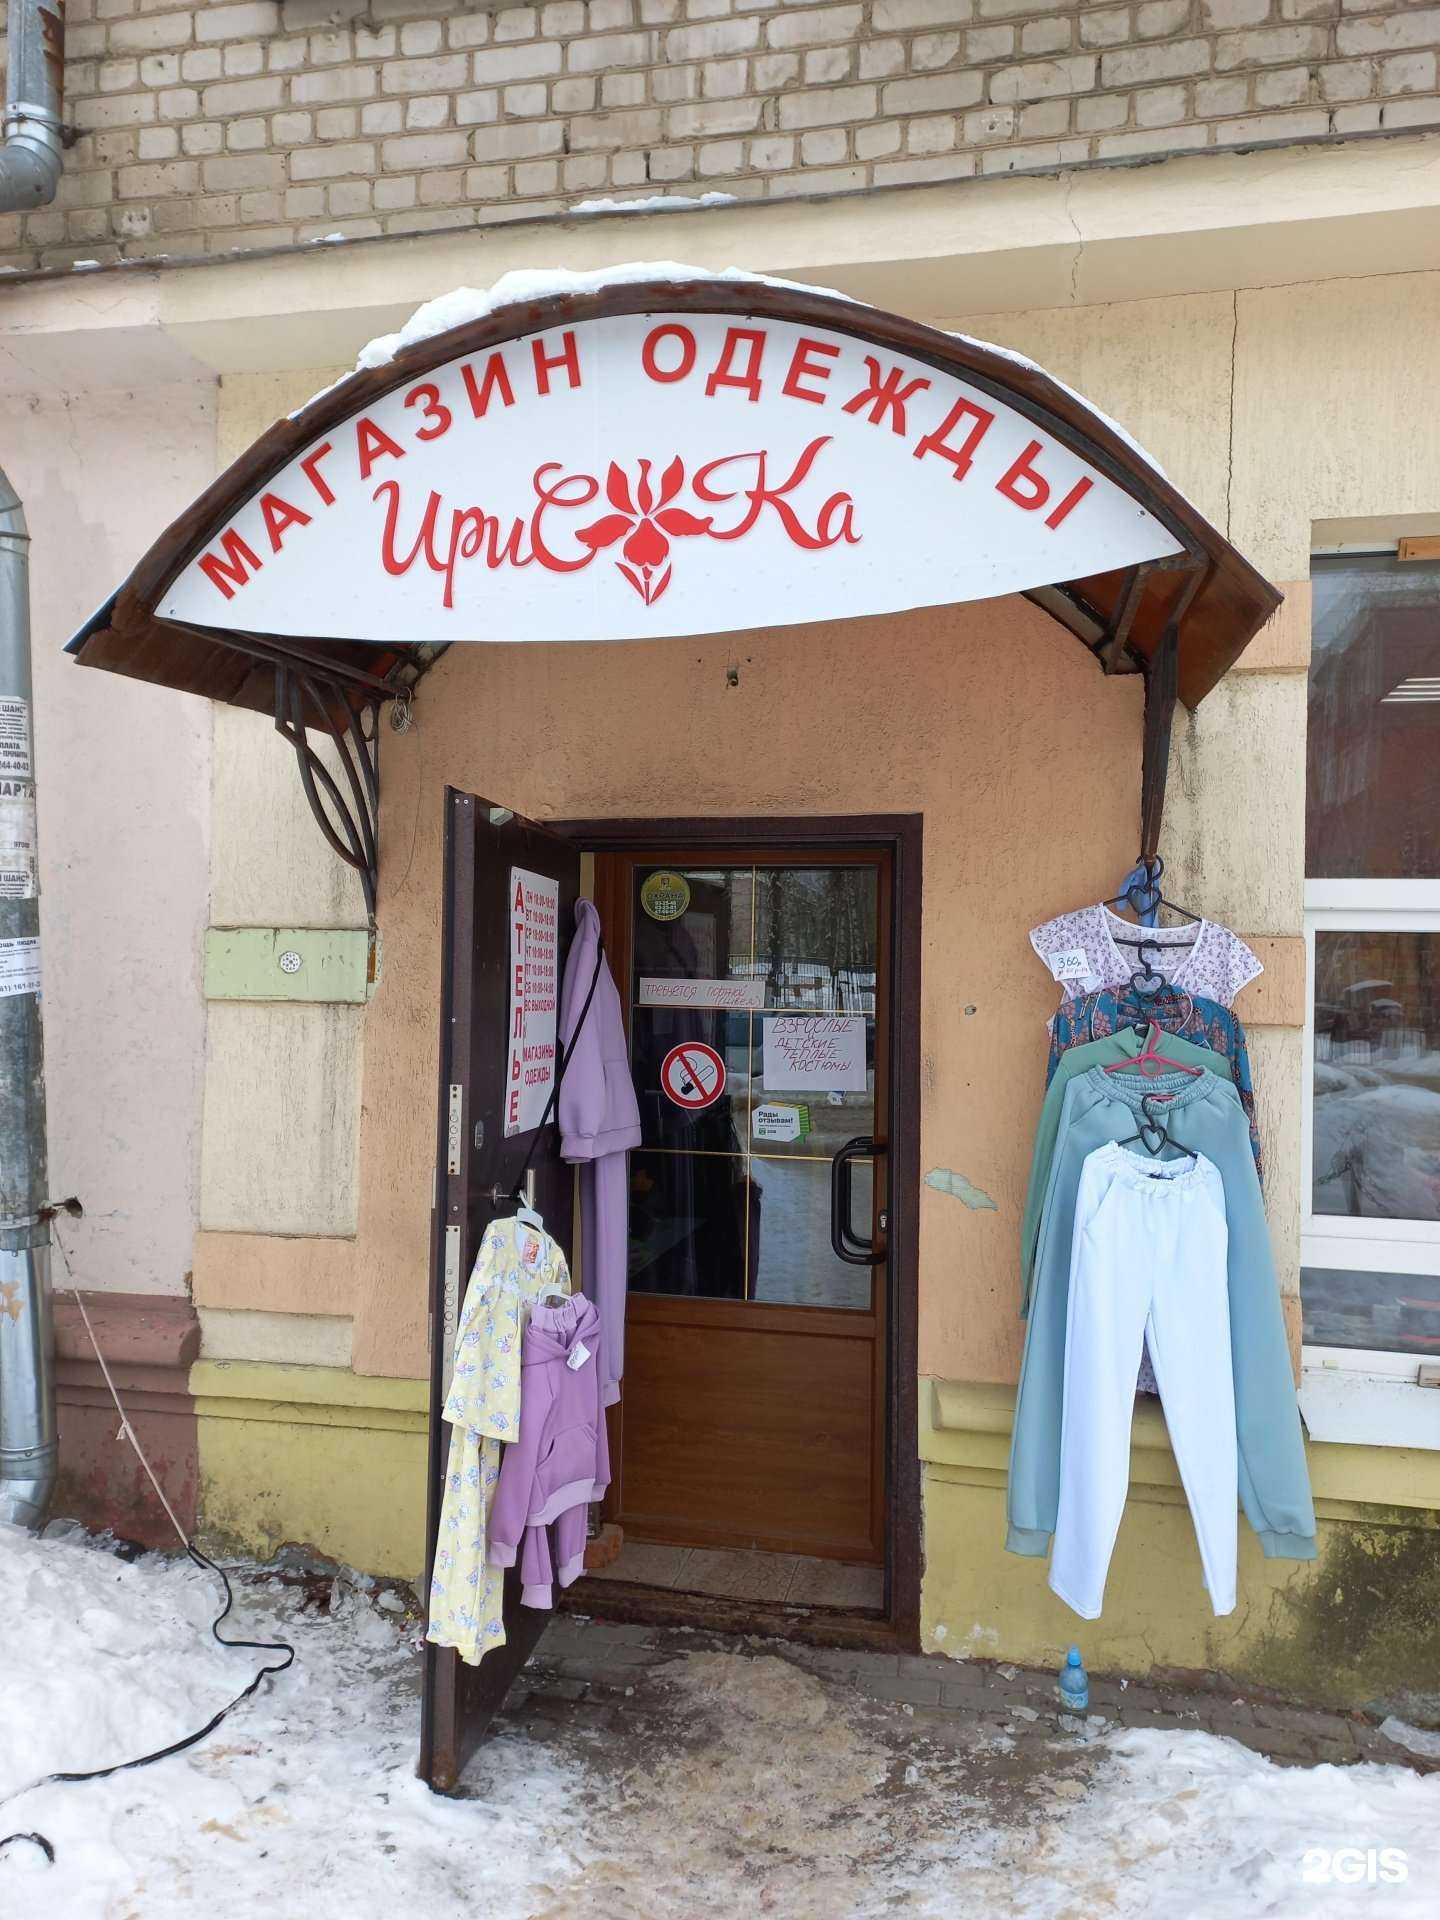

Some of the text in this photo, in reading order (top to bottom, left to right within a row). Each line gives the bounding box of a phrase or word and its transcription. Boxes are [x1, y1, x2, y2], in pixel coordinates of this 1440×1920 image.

[197, 322, 1095, 601] МАГАЗИН ОДЕЖДЫ
[0, 781, 35, 799] АРТА
[508, 881, 525, 1124] АТЕЛЬЕ
[772, 1017, 857, 1034] ВЗРОСЛЫЕ
[774, 1037, 841, 1049] ДЕТСКИЕ
[783, 1048, 843, 1059] ТЕПЛЫЕ
[524, 1066, 551, 1086] ОДЕЖДЫ
